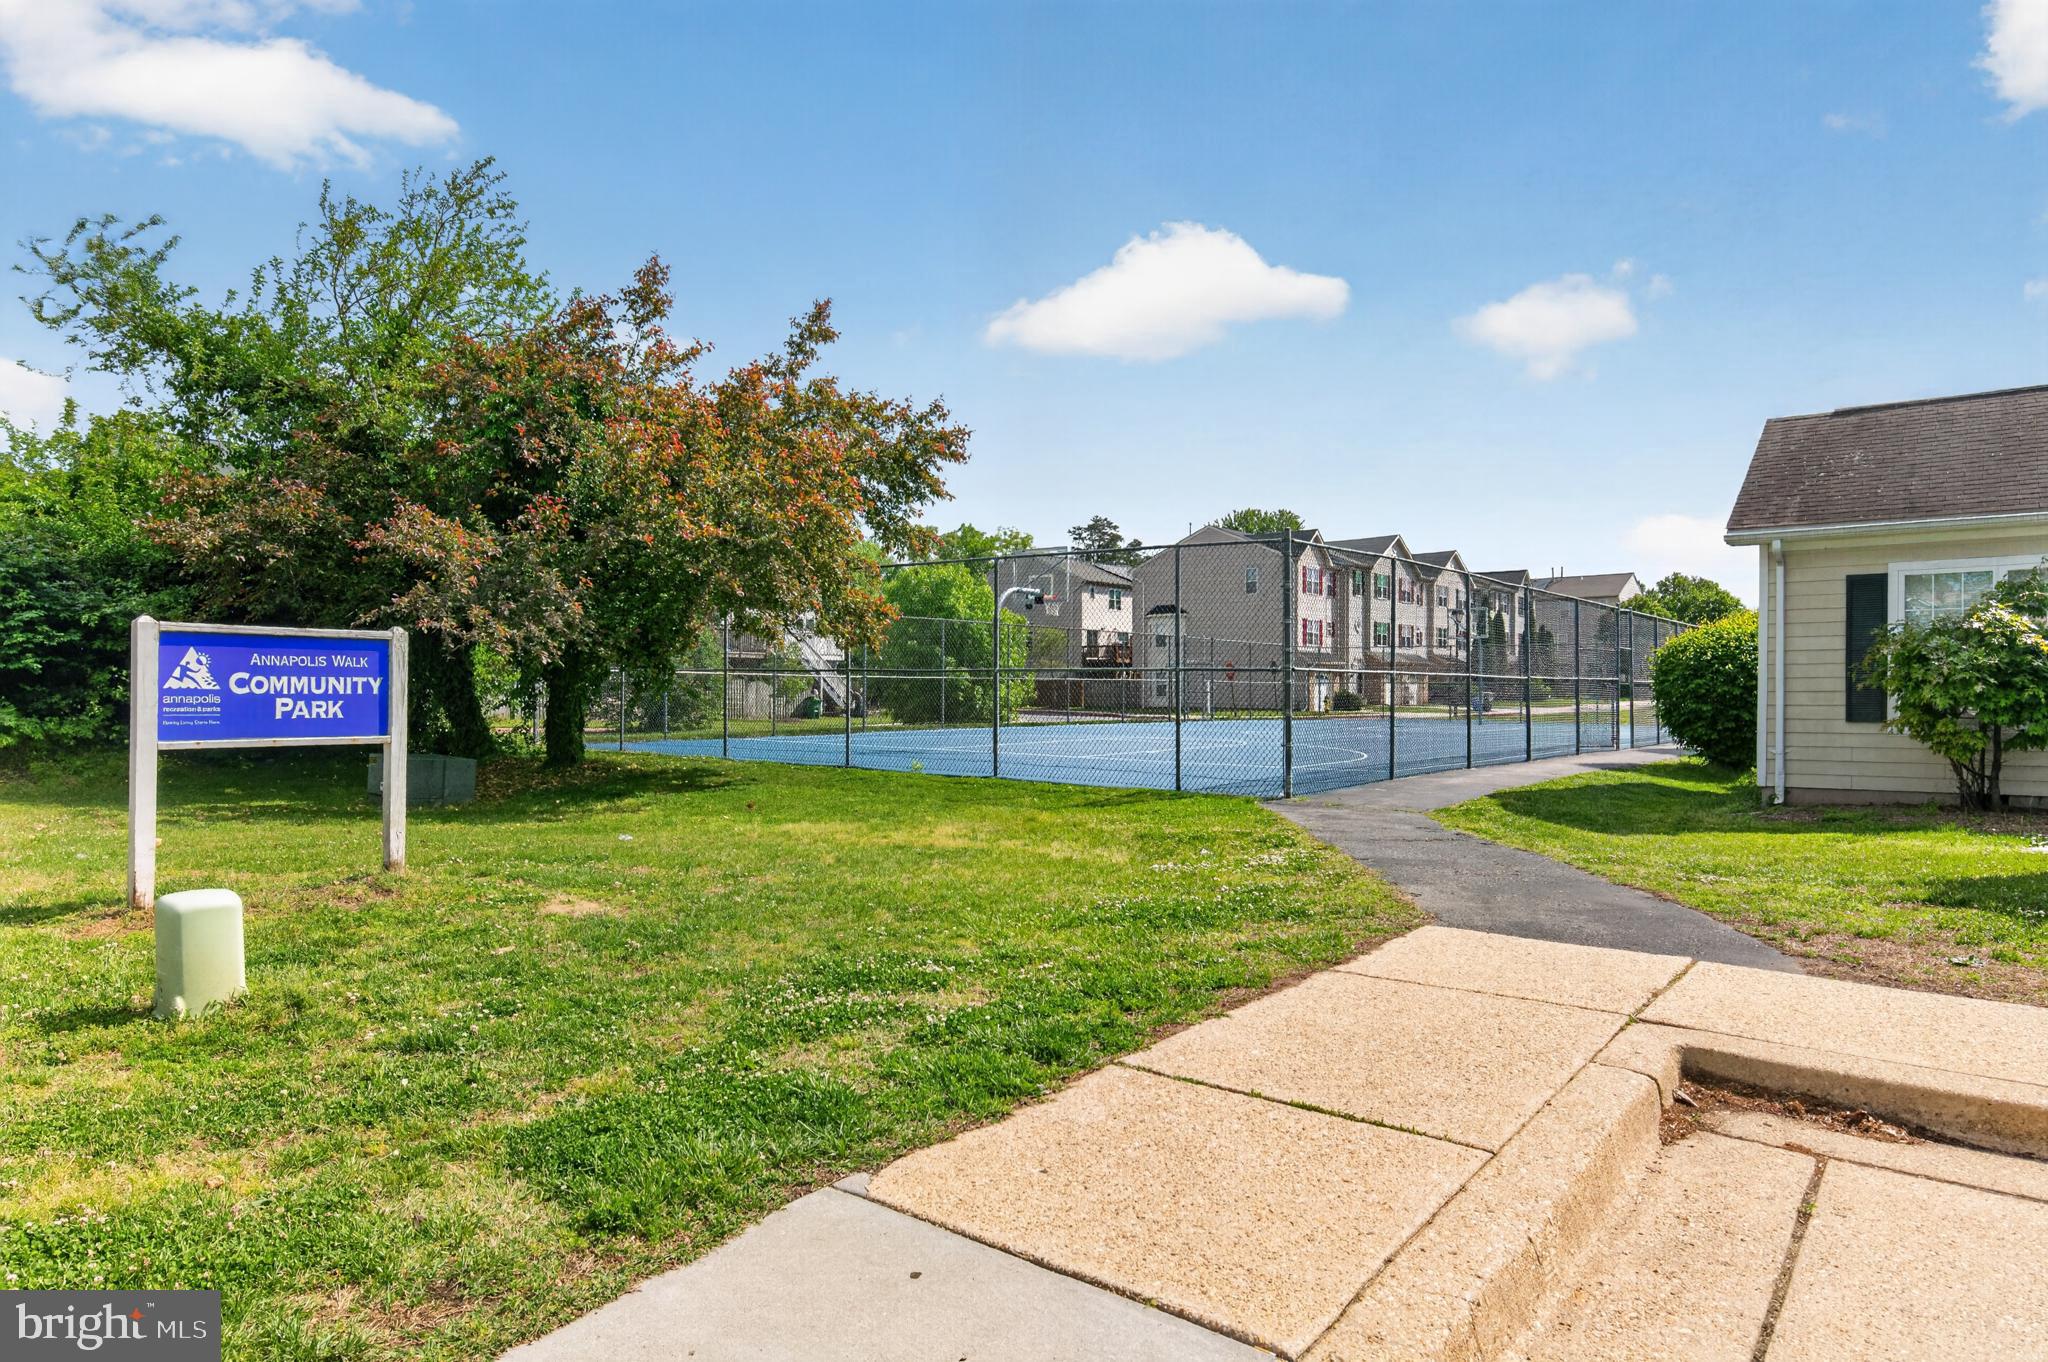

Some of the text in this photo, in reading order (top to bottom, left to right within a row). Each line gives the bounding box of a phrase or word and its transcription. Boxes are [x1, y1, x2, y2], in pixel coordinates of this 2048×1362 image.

[250, 653, 368, 668] ANNAPOLIS WALK
[229, 672, 383, 695] COMMUNITY
[163, 694, 221, 704] annapolis
[275, 697, 344, 719] PARK
